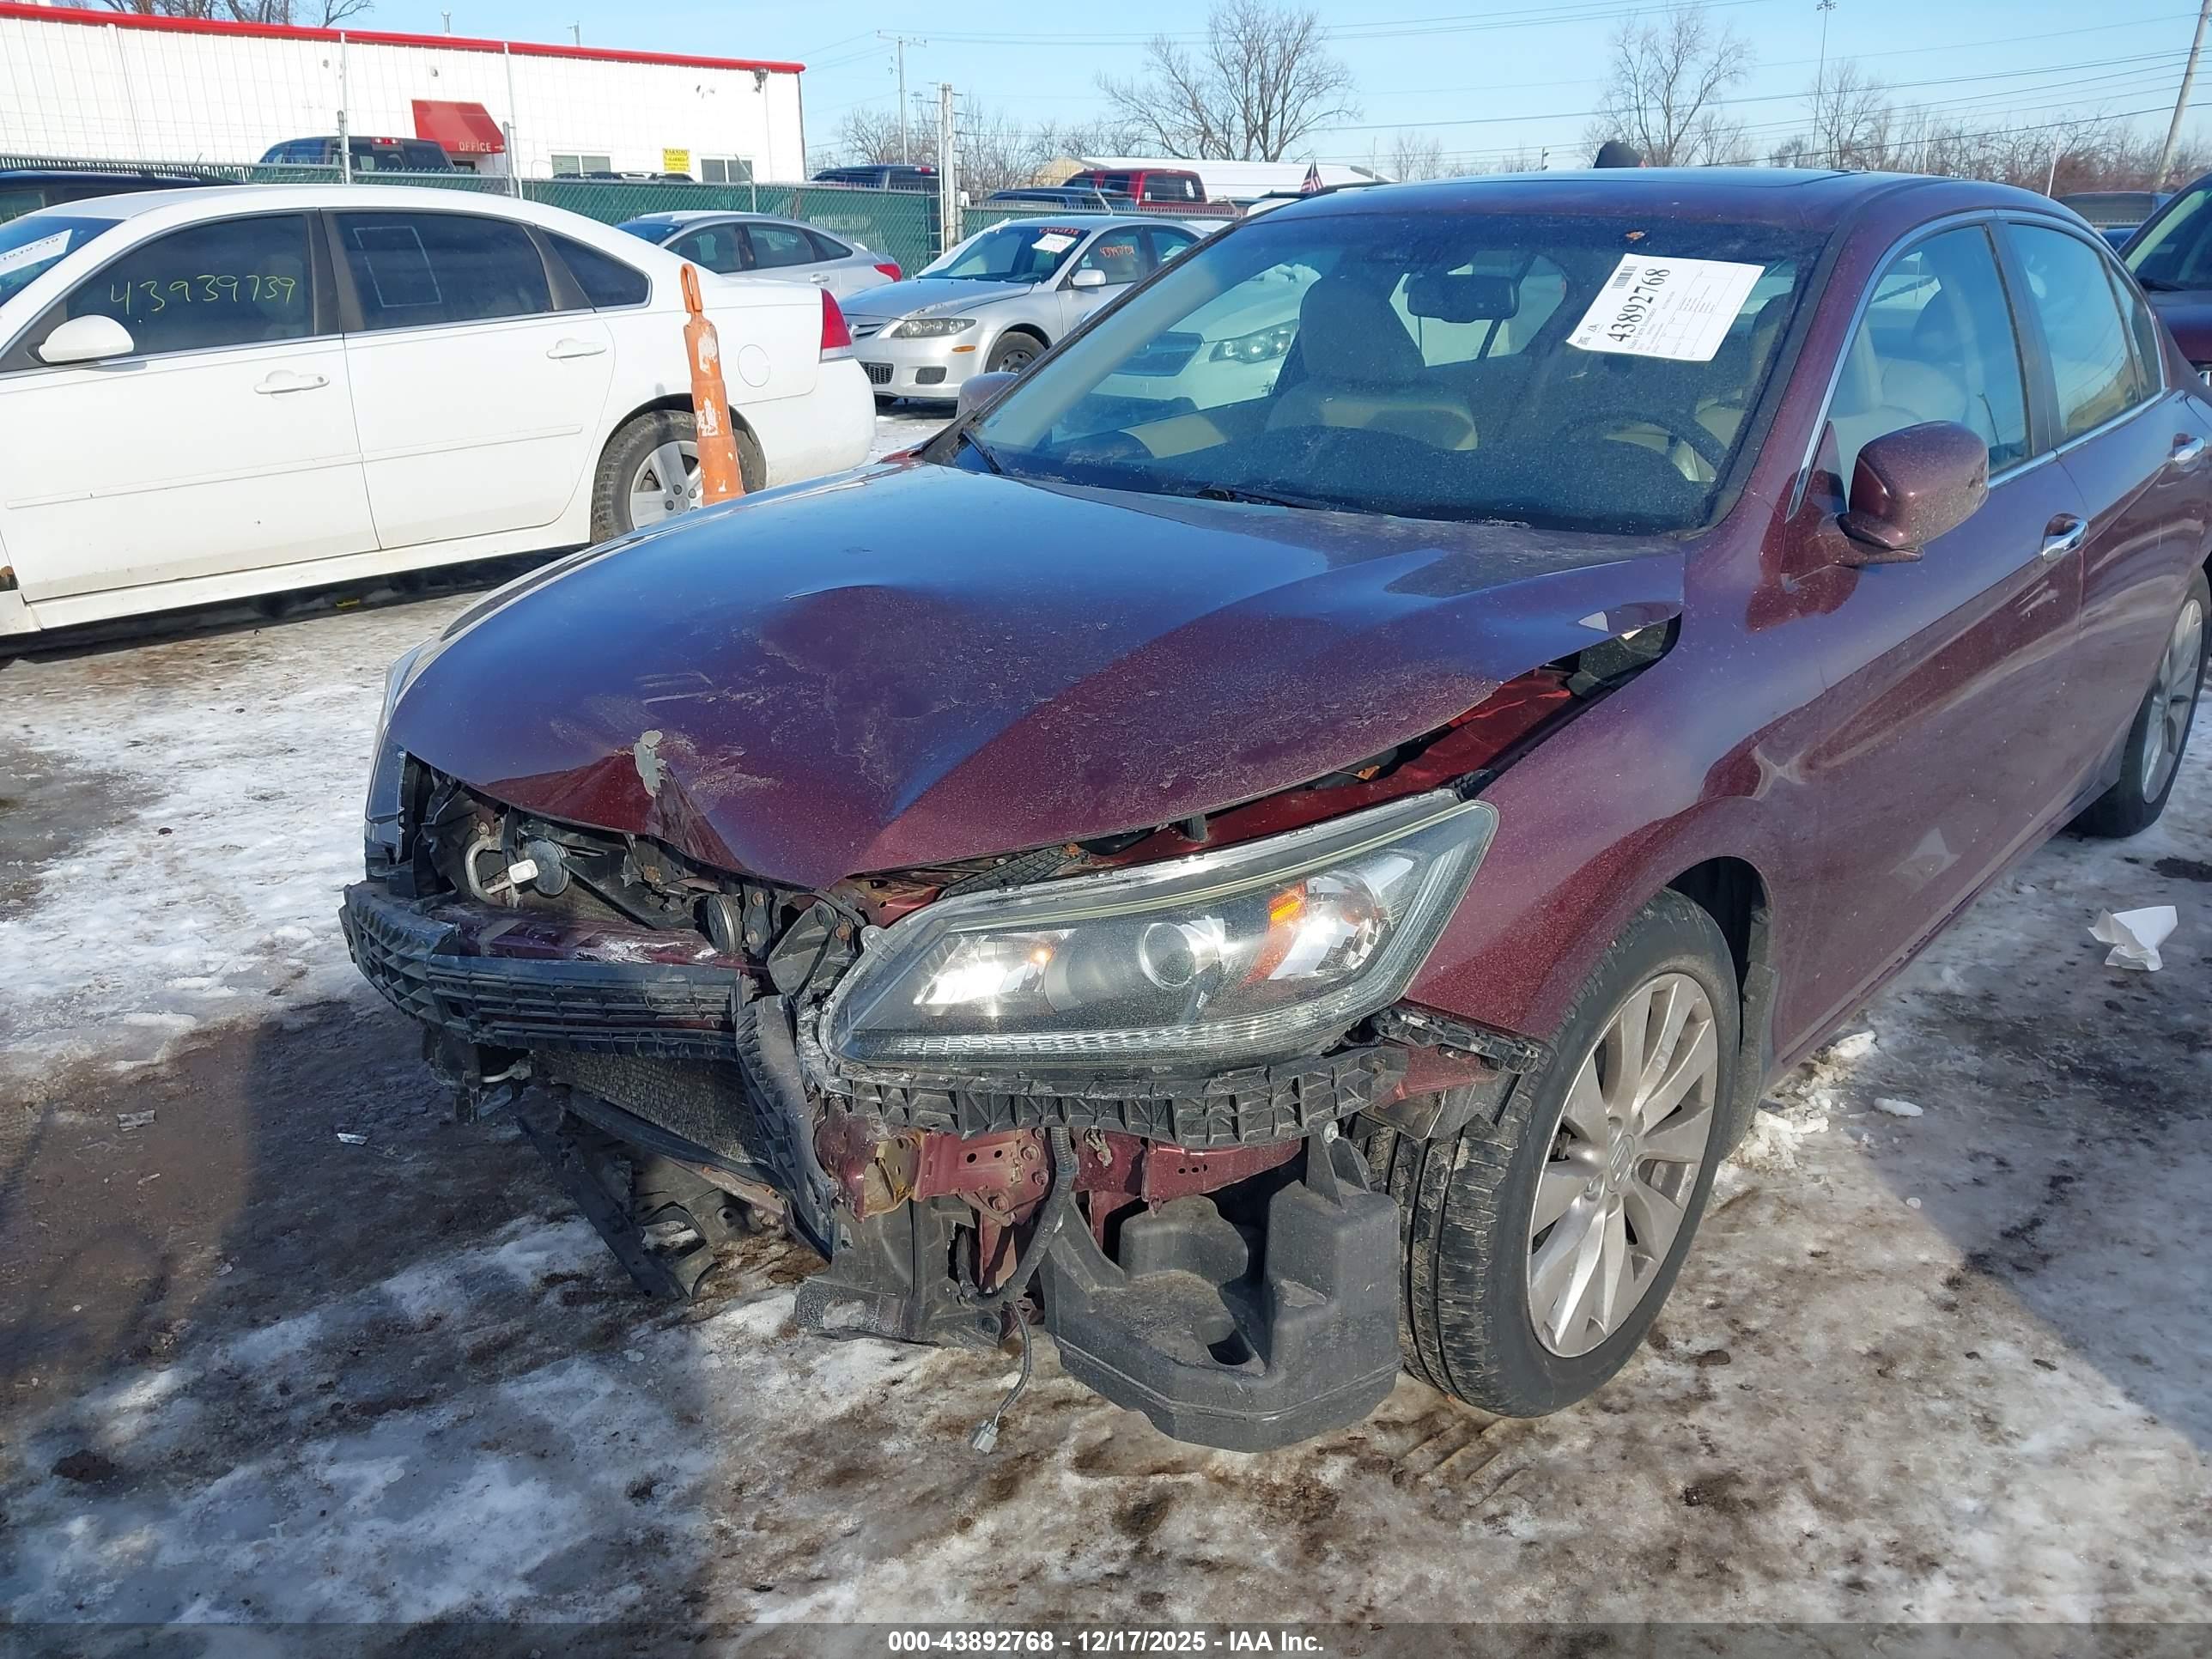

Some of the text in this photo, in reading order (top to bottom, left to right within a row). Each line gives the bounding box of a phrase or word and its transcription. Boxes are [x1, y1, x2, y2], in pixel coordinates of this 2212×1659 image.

[459, 141, 491, 152] OFFICE
[111, 275, 296, 315] 43939739
[1607, 268, 1671, 343] 43892768
